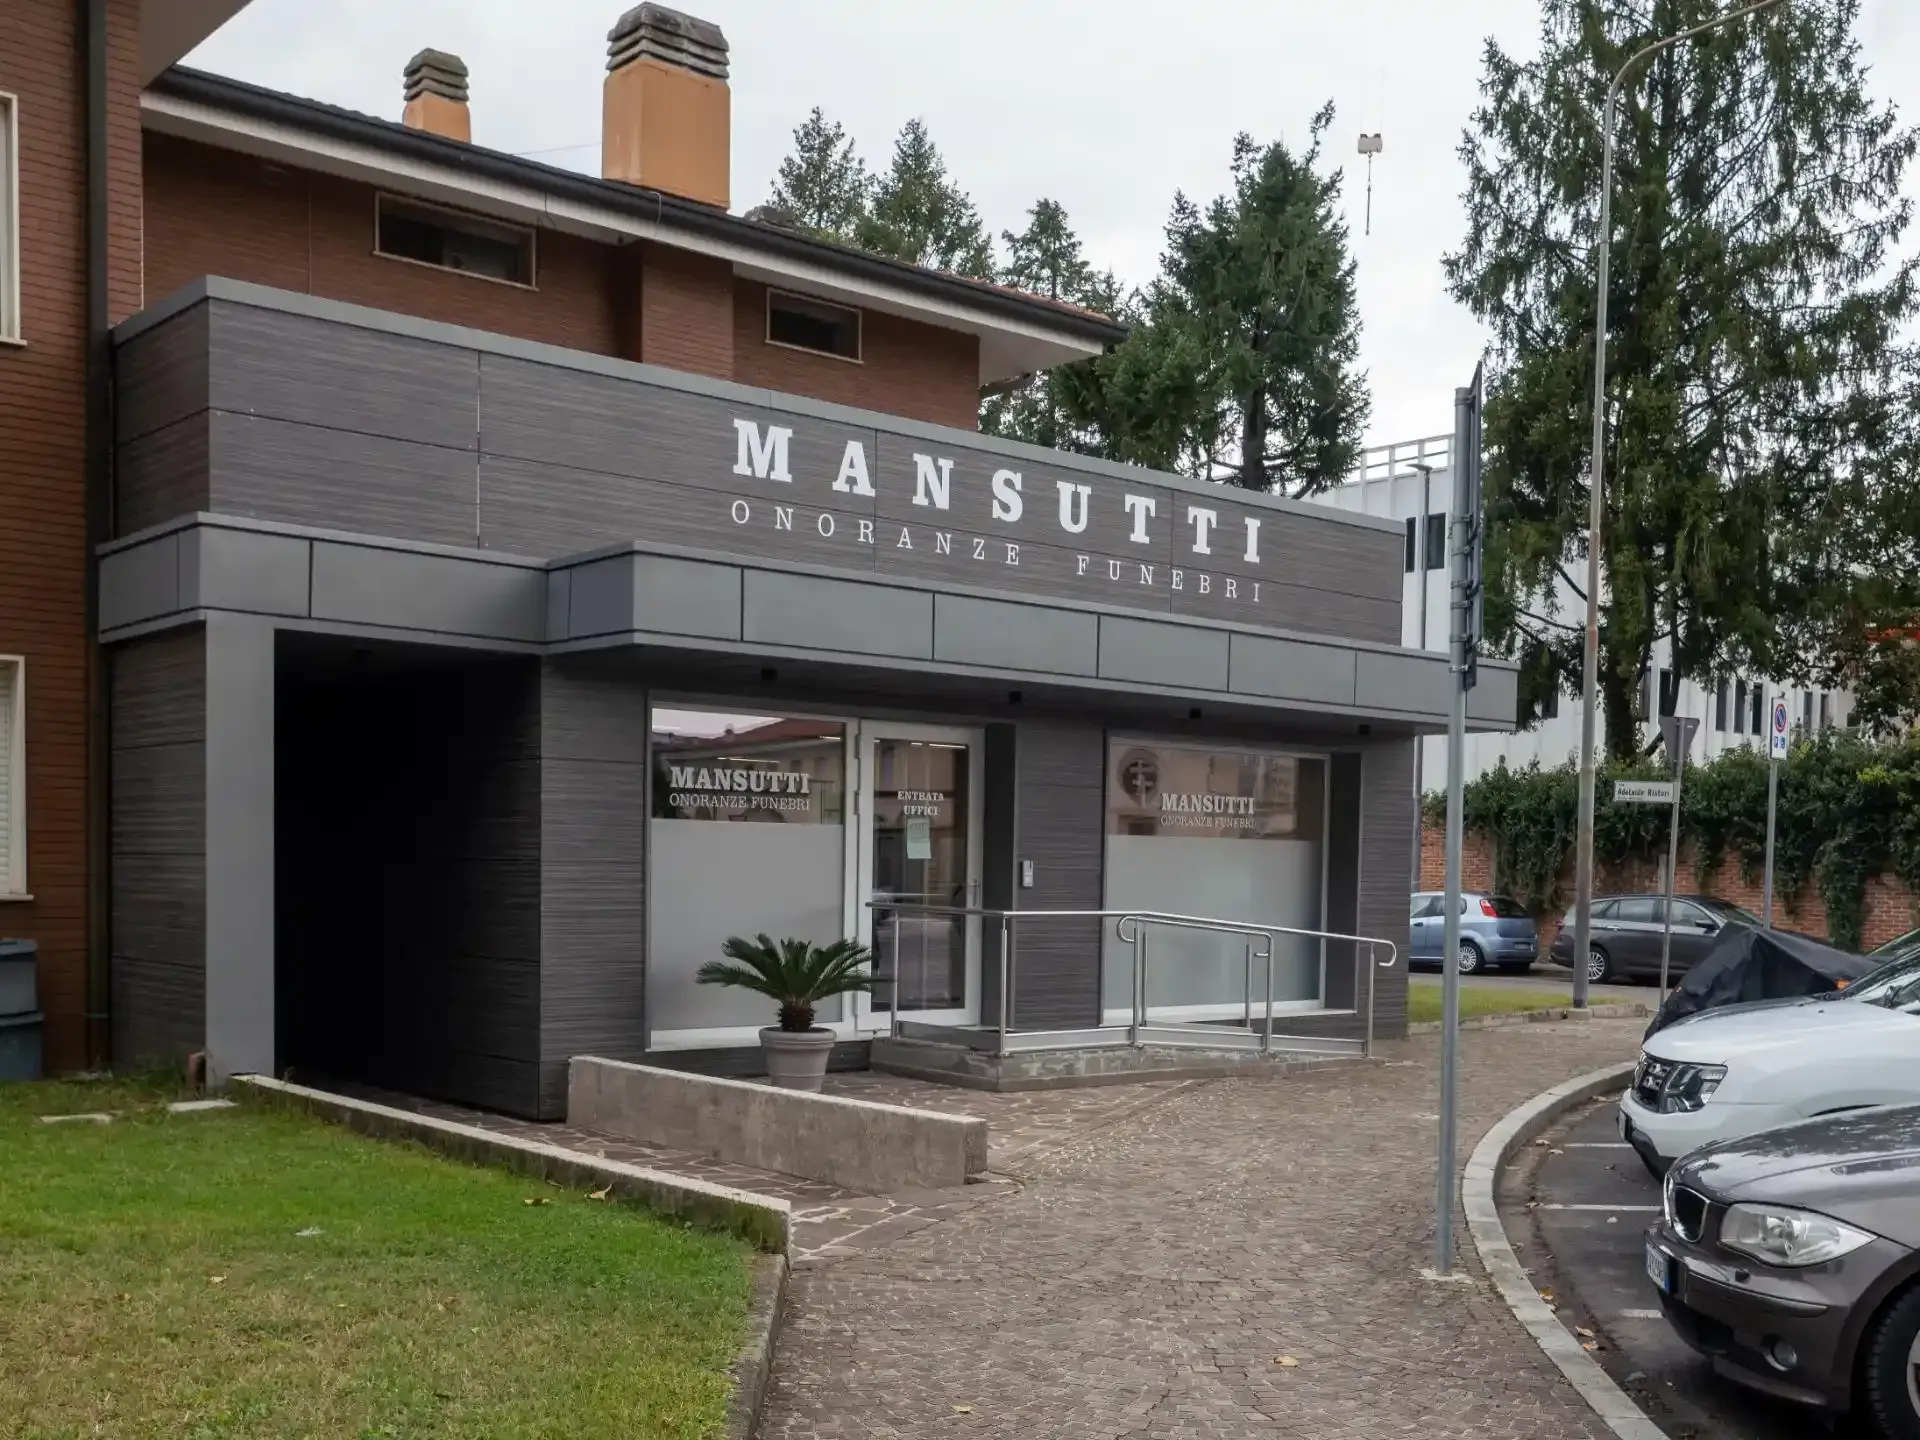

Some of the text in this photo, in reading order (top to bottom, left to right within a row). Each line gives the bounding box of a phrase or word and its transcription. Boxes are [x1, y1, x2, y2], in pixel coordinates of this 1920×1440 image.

[732, 417, 1261, 564] MANSUTTI
[731, 500, 1261, 603] ONORANZE FUNEBRI
[670, 766, 811, 794] MANSUTTI
[897, 790, 945, 801] ENTRATA
[1647, 788, 1670, 797] Ristori
[669, 793, 811, 811] ONORANZE FUNEBRI
[903, 805, 939, 816] UFFICI
[1161, 792, 1255, 815] MANSUTTI
[1160, 814, 1256, 829] ONORANZE FUNEBRI
